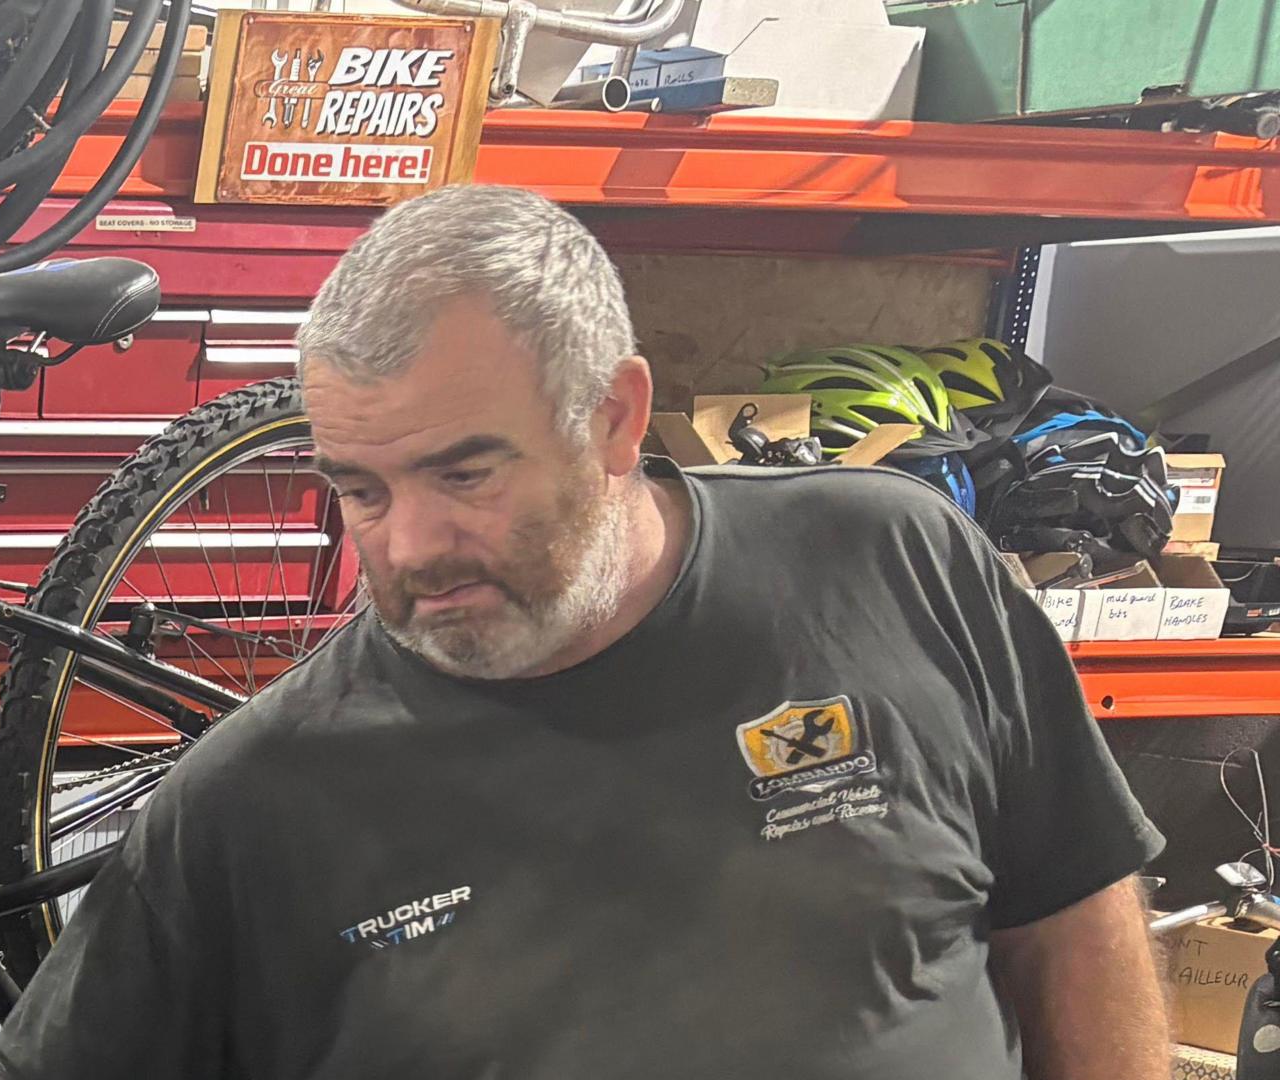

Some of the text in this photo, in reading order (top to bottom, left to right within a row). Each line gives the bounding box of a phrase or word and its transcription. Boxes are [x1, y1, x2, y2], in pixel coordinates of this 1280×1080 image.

[328, 47, 455, 87] BIKE
[315, 90, 444, 137] REPAIRS
[244, 144, 433, 179] Done here!
[755, 755, 869, 796] LOMBARDO
[340, 885, 472, 944] TRUCKER
[386, 916, 435, 945] TIM
